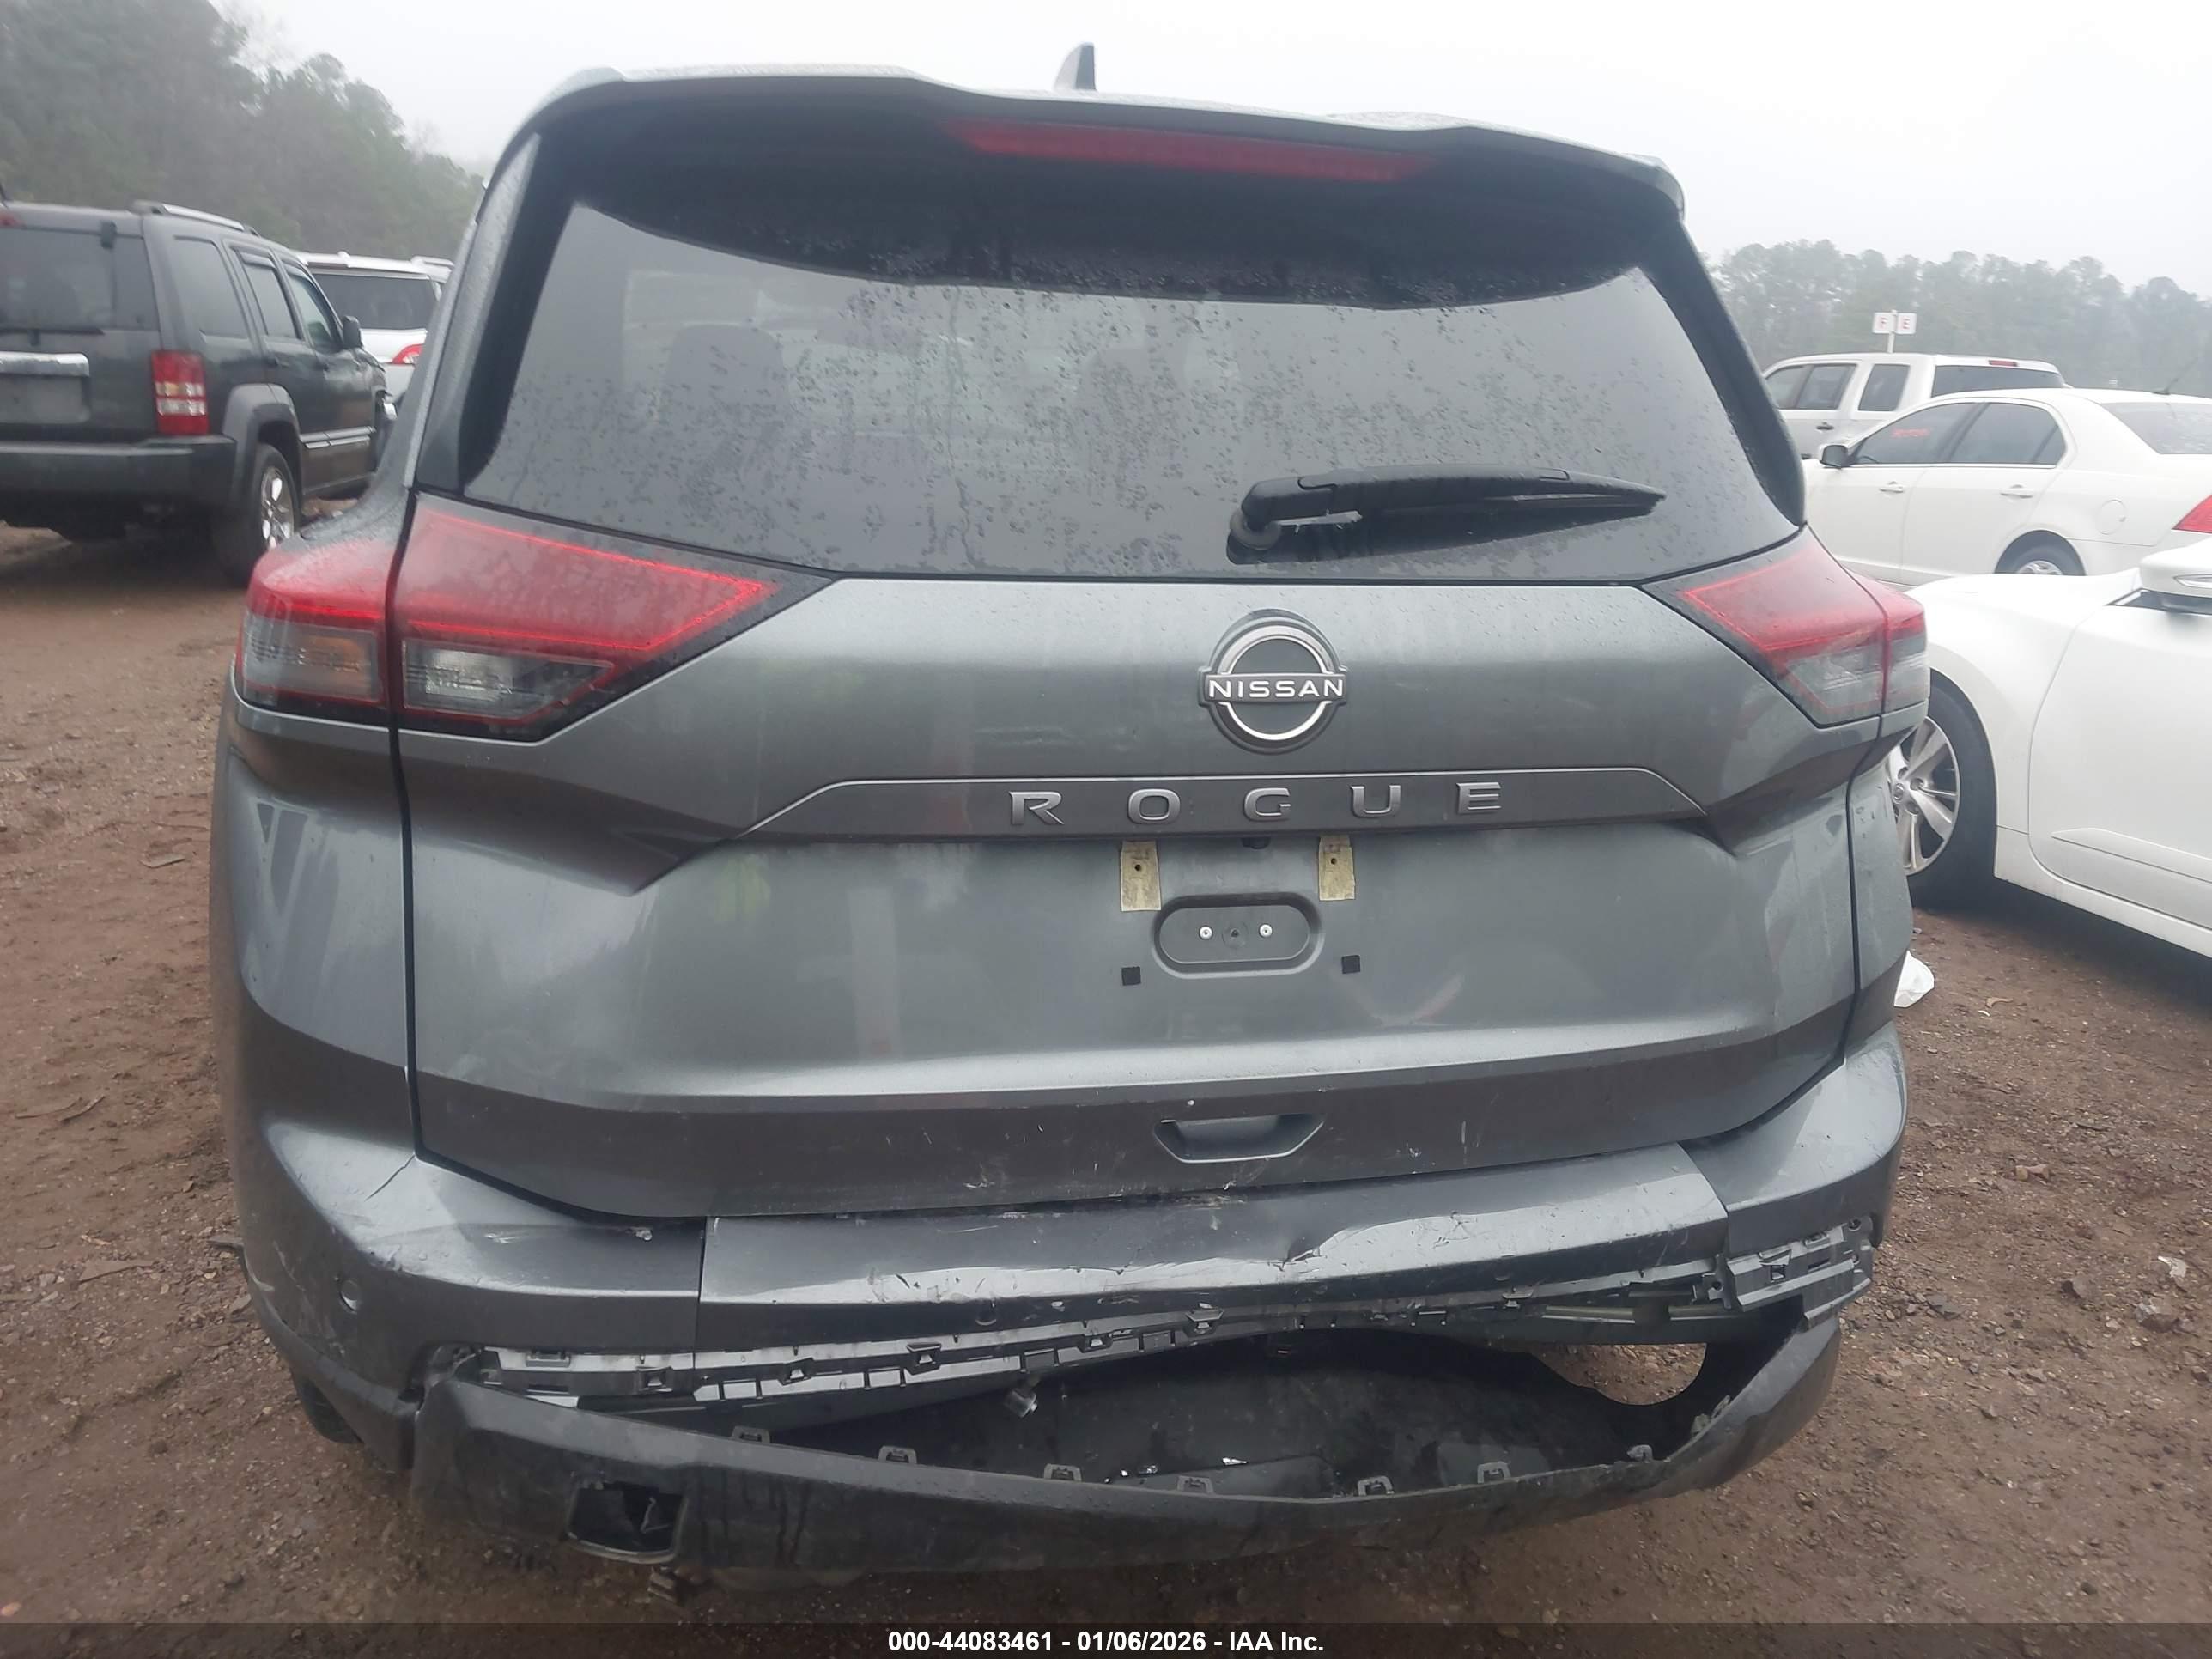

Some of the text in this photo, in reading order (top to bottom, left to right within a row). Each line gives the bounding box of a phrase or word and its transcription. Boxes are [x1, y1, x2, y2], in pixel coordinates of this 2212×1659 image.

[1900, 317, 1911, 330] E
[1208, 679, 1343, 698] NISSAN
[1009, 781, 1501, 825] ROGUE
